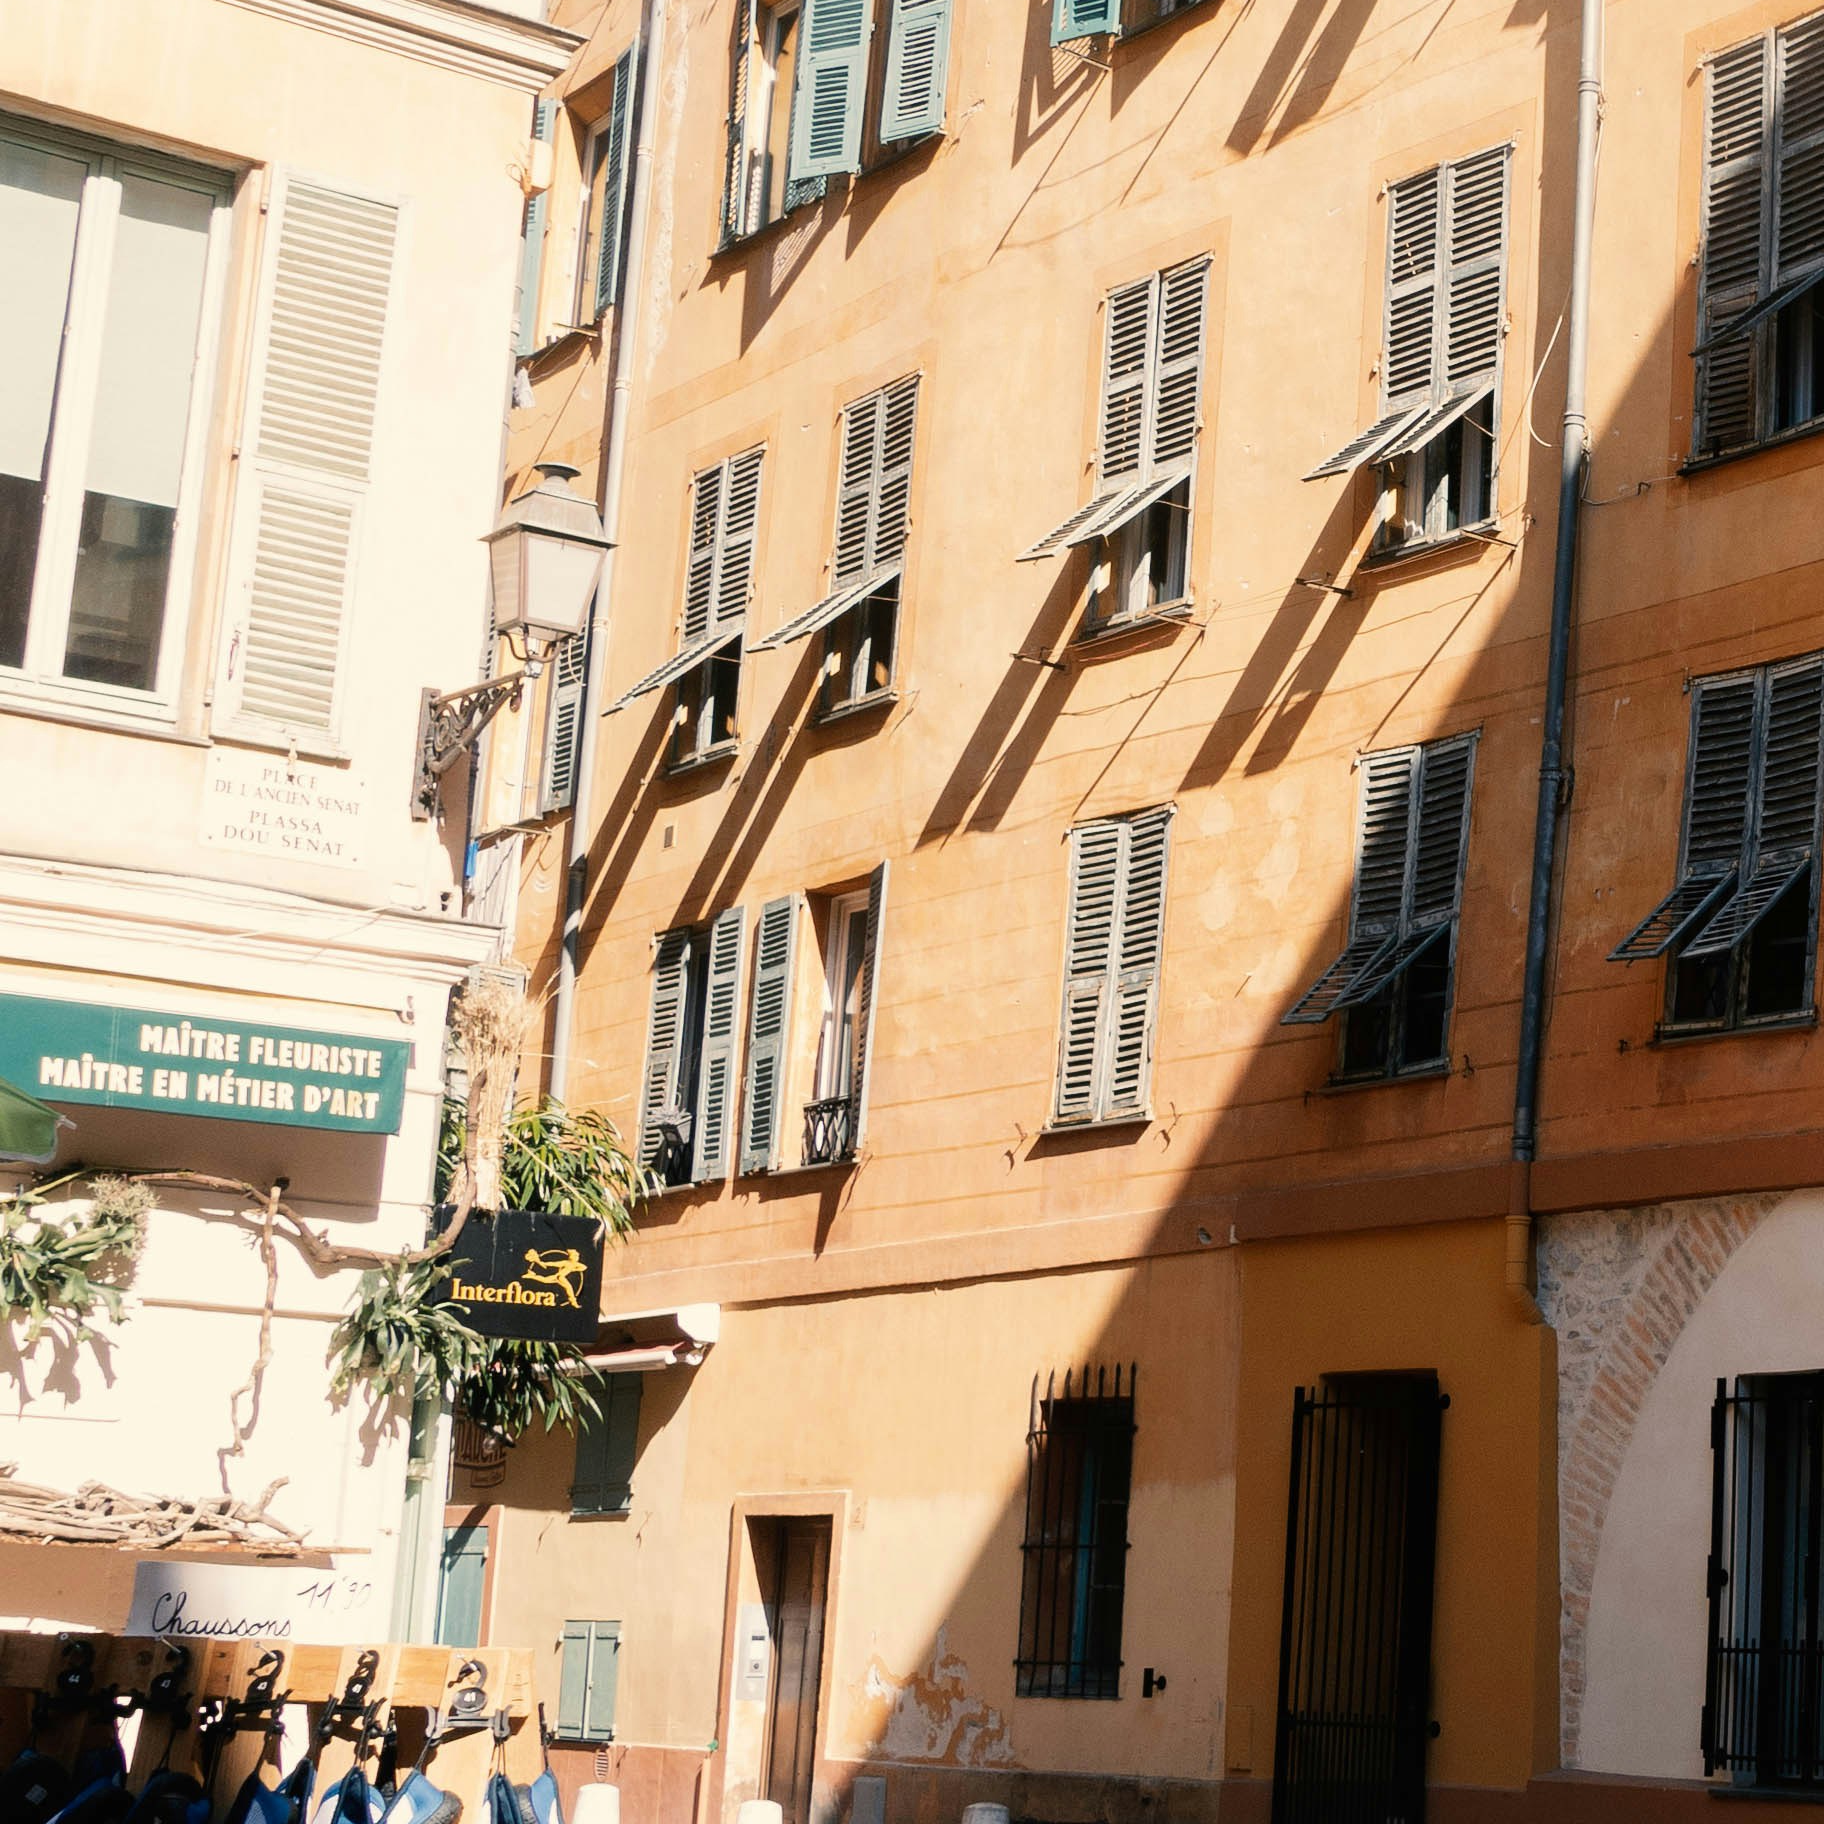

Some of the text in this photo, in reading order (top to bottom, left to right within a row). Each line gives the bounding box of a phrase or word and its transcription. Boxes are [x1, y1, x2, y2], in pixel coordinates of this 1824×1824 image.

[239, 783, 311, 806] LANCIEN
[249, 809, 323, 835] PLASSA
[223, 824, 344, 856] DOU SENAT
[140, 1021, 383, 1078] MAÎTRE FLEURISTE
[38, 1053, 144, 1095] MAÎTRE
[152, 1069, 188, 1100] EN
[196, 1069, 295, 1111] MÉTIER
[450, 1277, 557, 1307] Interflora
[151, 1591, 292, 1637] Chaussons
